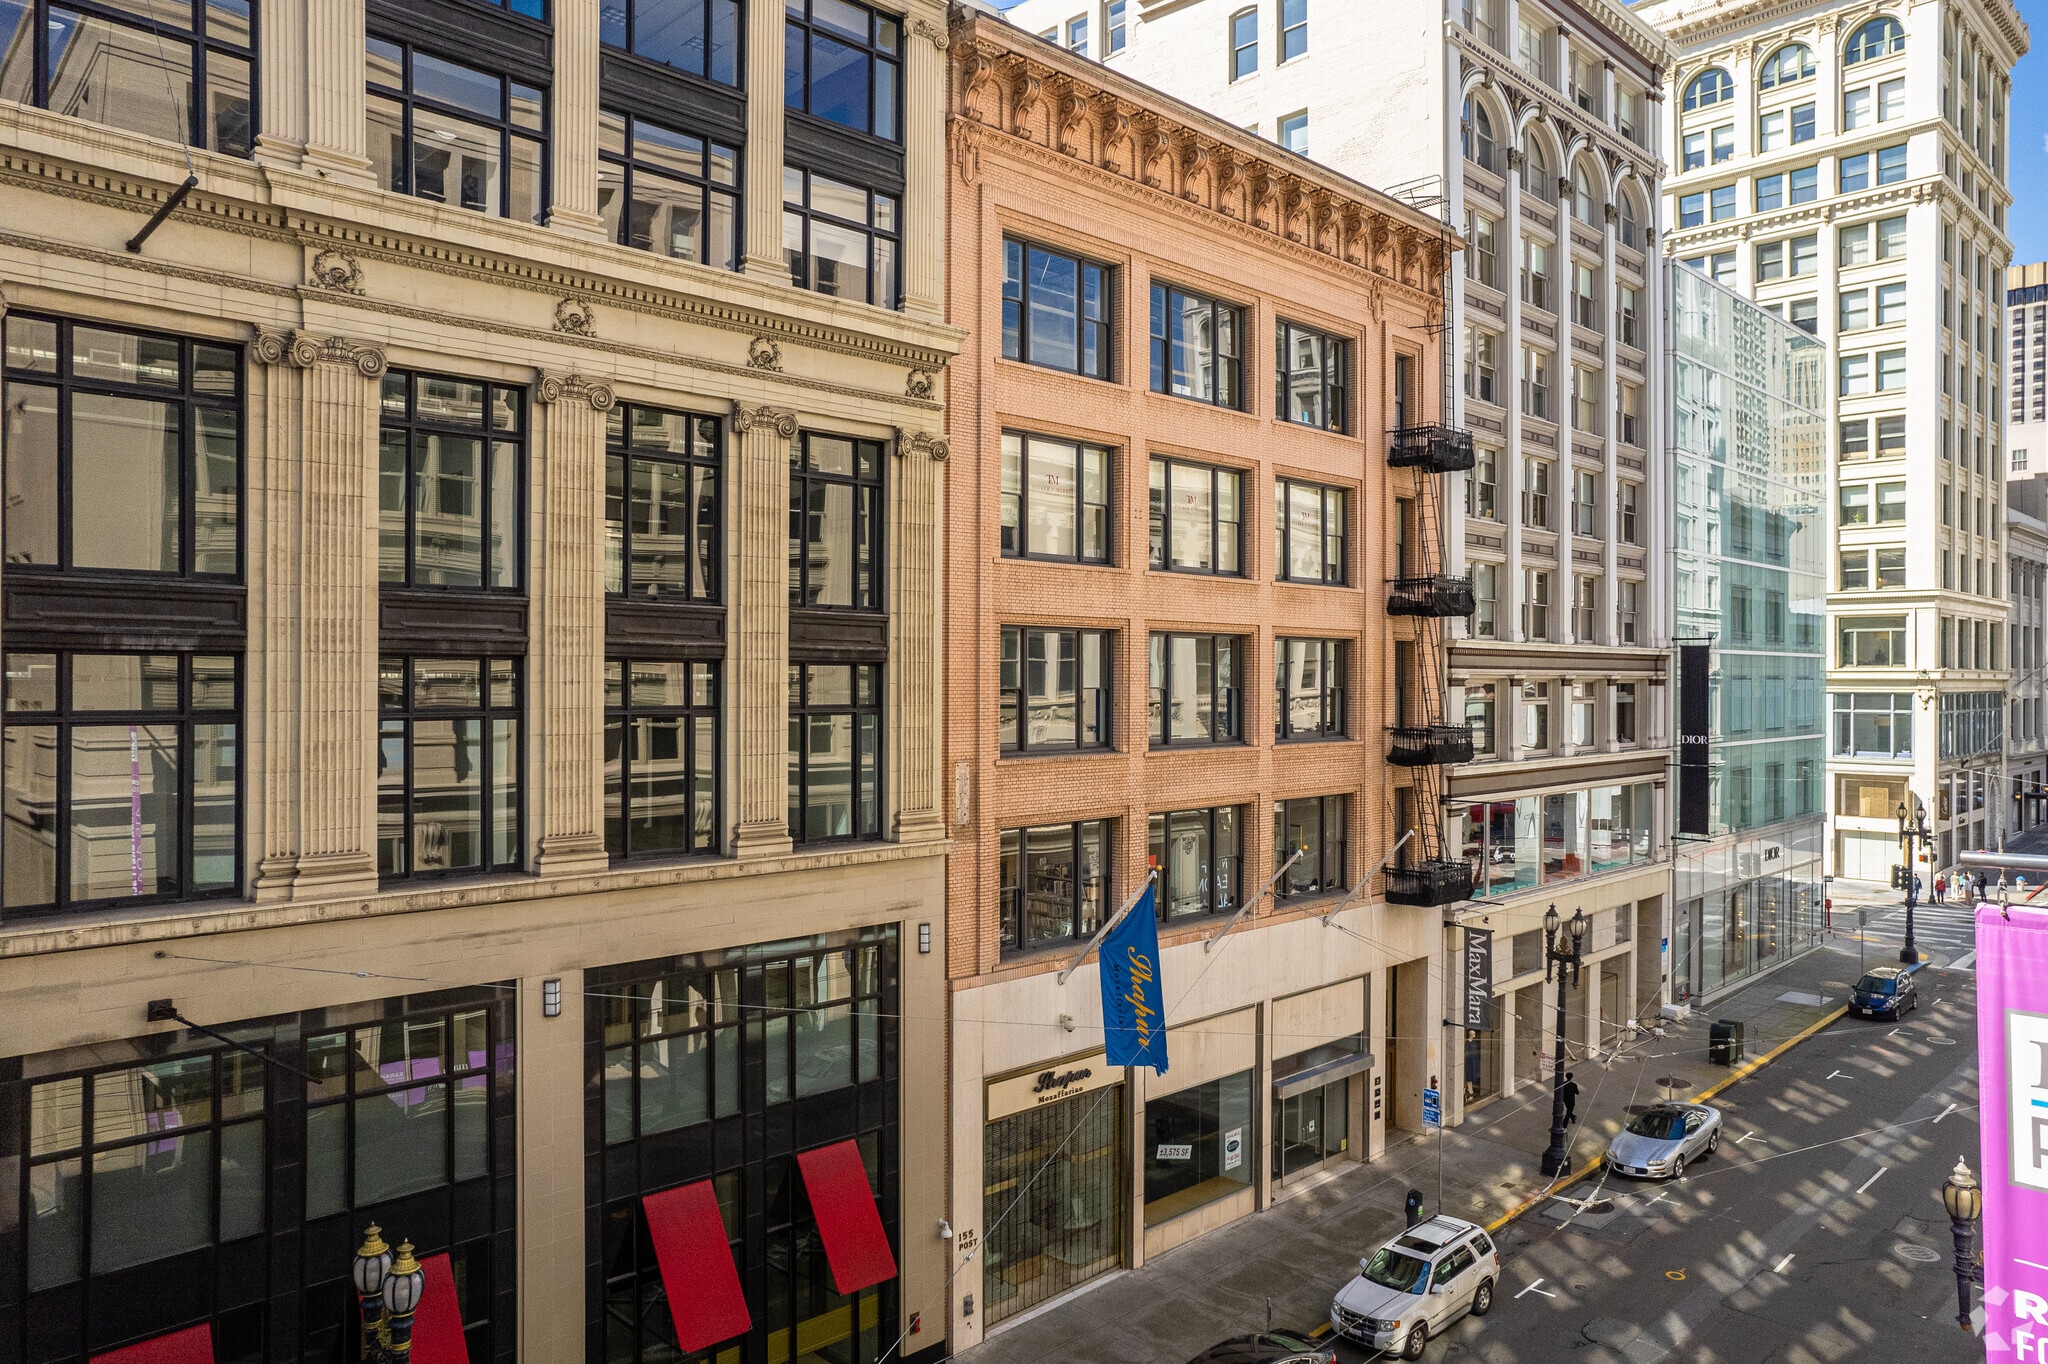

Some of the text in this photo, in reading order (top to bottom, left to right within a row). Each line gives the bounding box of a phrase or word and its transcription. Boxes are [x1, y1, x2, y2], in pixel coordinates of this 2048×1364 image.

[1681, 735, 1708, 744] DIOR
[1764, 846, 1780, 861] DIOR
[1468, 931, 1488, 1024] MaxMara
[1125, 946, 1155, 1053] Shapur
[1033, 1068, 1092, 1093] Shapur
[1038, 1086, 1084, 1103] Mozaffarian
[1160, 1147, 1189, 1157] ±3,575 SF
[959, 1229, 974, 1242] 155
[959, 1238, 978, 1251] POST
